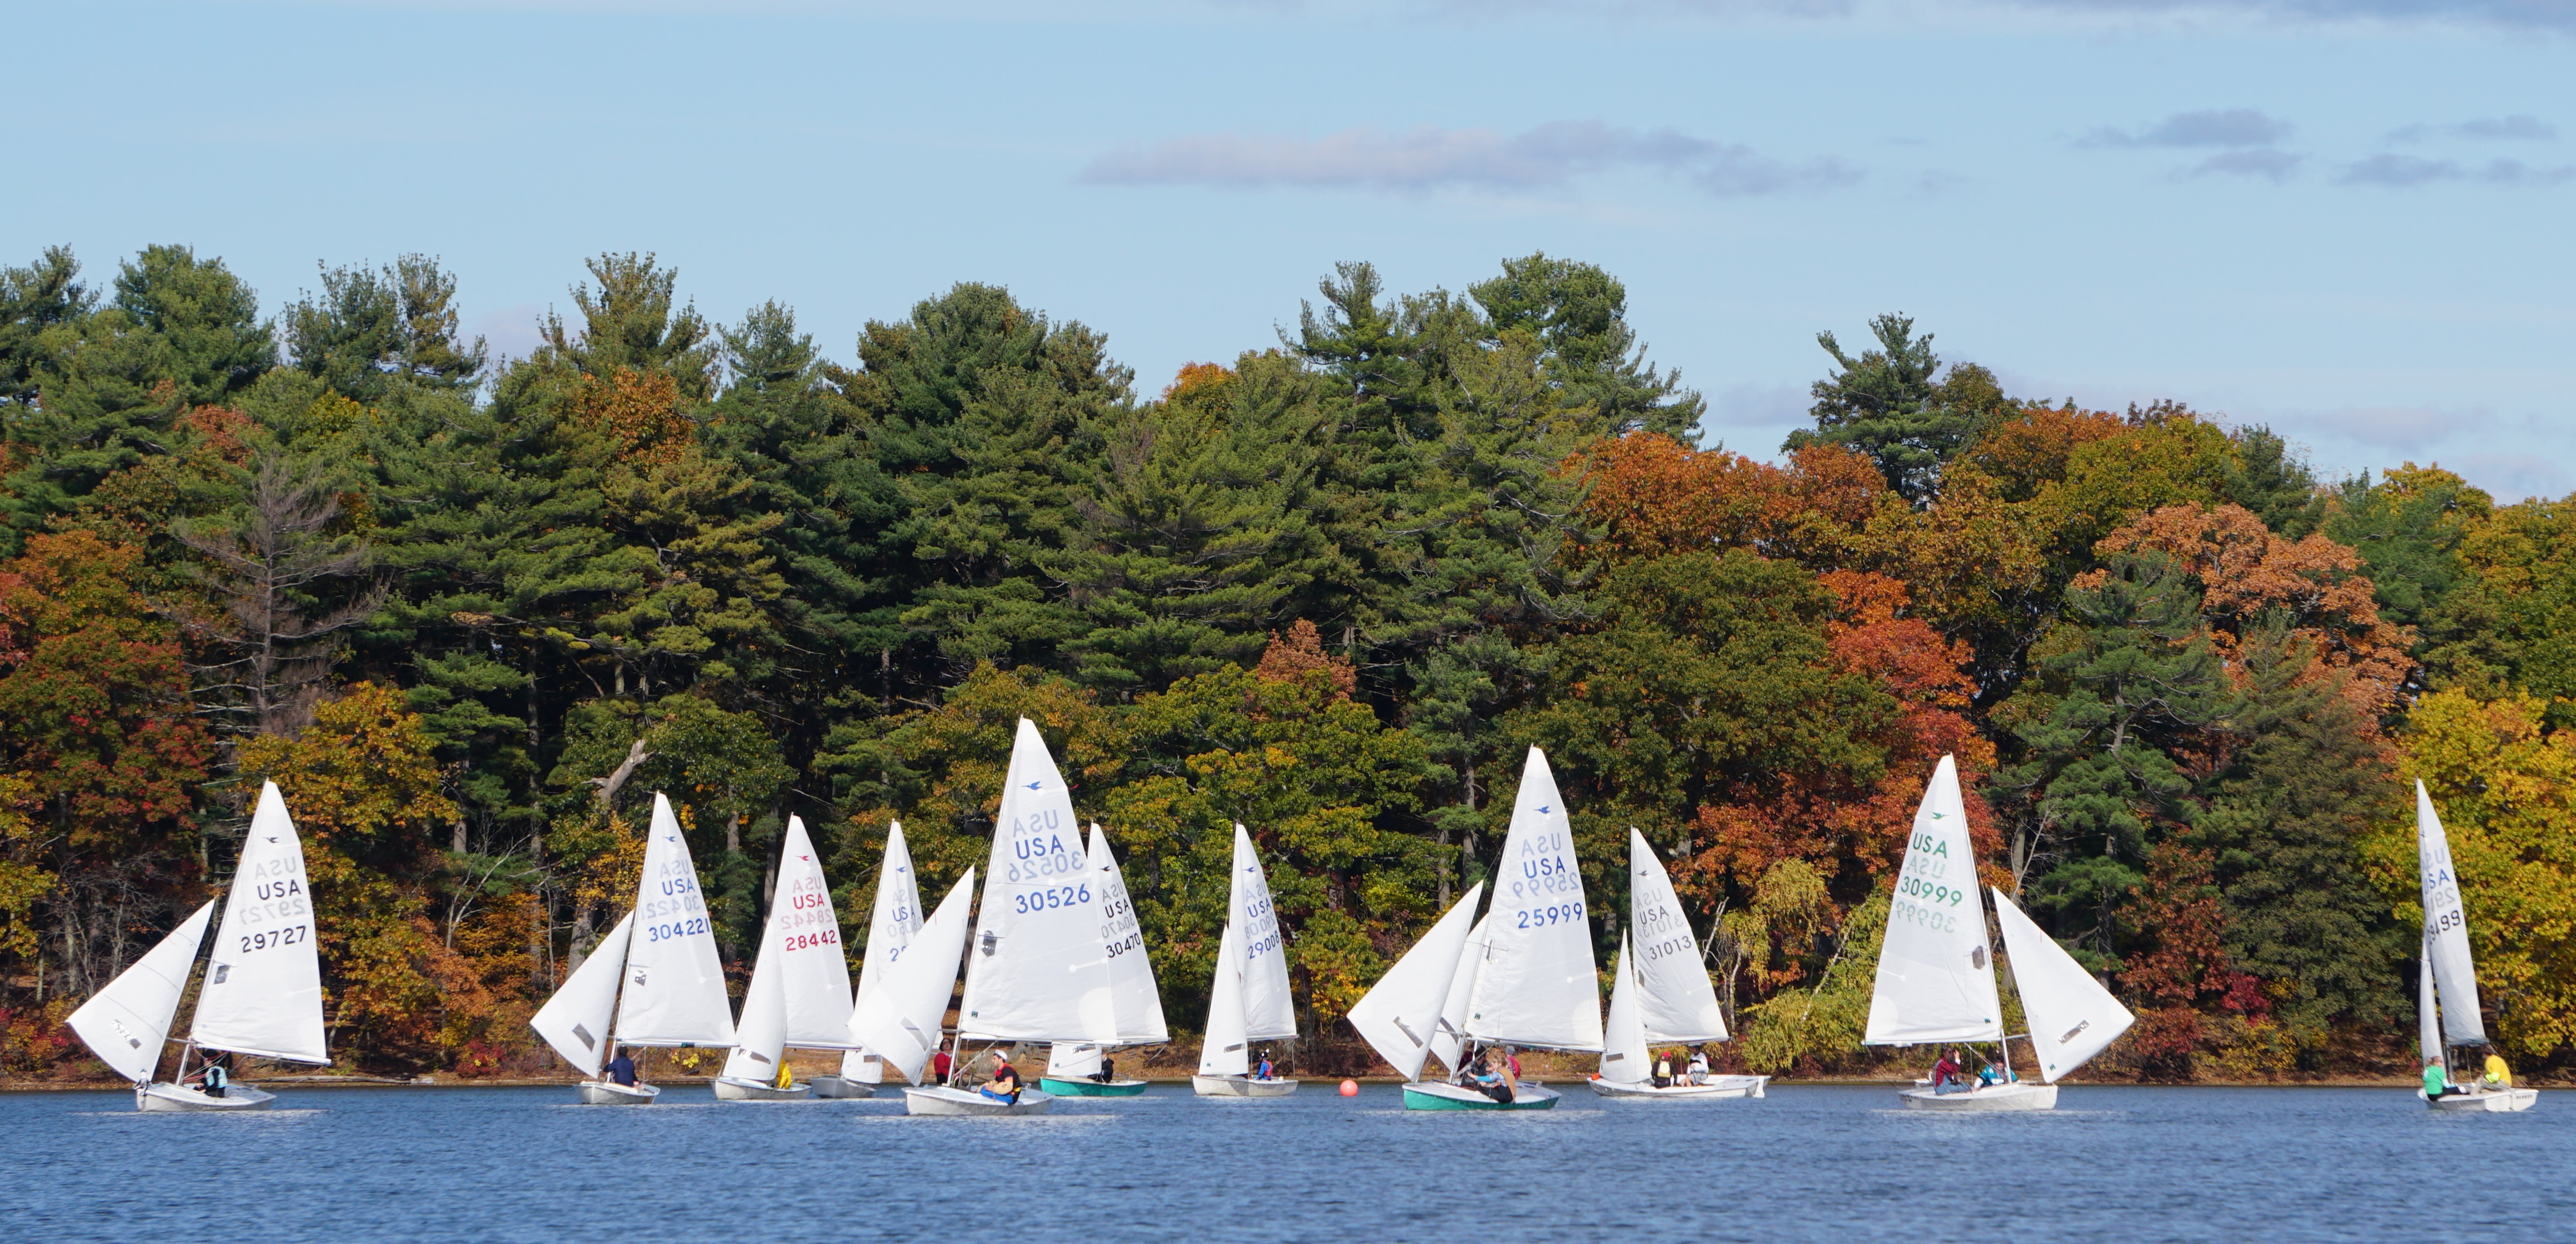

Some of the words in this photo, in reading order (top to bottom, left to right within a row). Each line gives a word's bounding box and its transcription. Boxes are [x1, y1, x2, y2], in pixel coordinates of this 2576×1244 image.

[1015, 834, 1065, 860] USA
[1913, 832, 1948, 859] USA
[1523, 856, 1566, 879] USA
[257, 879, 301, 900] USA
[662, 877, 695, 896] USA
[1016, 883, 1090, 914] 30526
[1901, 876, 1962, 906] 30999
[793, 893, 825, 910] USA
[892, 905, 916, 922] USA
[1105, 898, 1130, 918] USA
[1248, 897, 1271, 918] USA
[1517, 903, 1582, 929] 25999
[1639, 905, 1669, 925] USA
[241, 925, 306, 953] 29727
[649, 918, 710, 942] 304221
[786, 930, 837, 952] 28442
[1106, 933, 1141, 958] 30470
[1248, 930, 1280, 959] 29008
[1649, 936, 1692, 960] 31013
